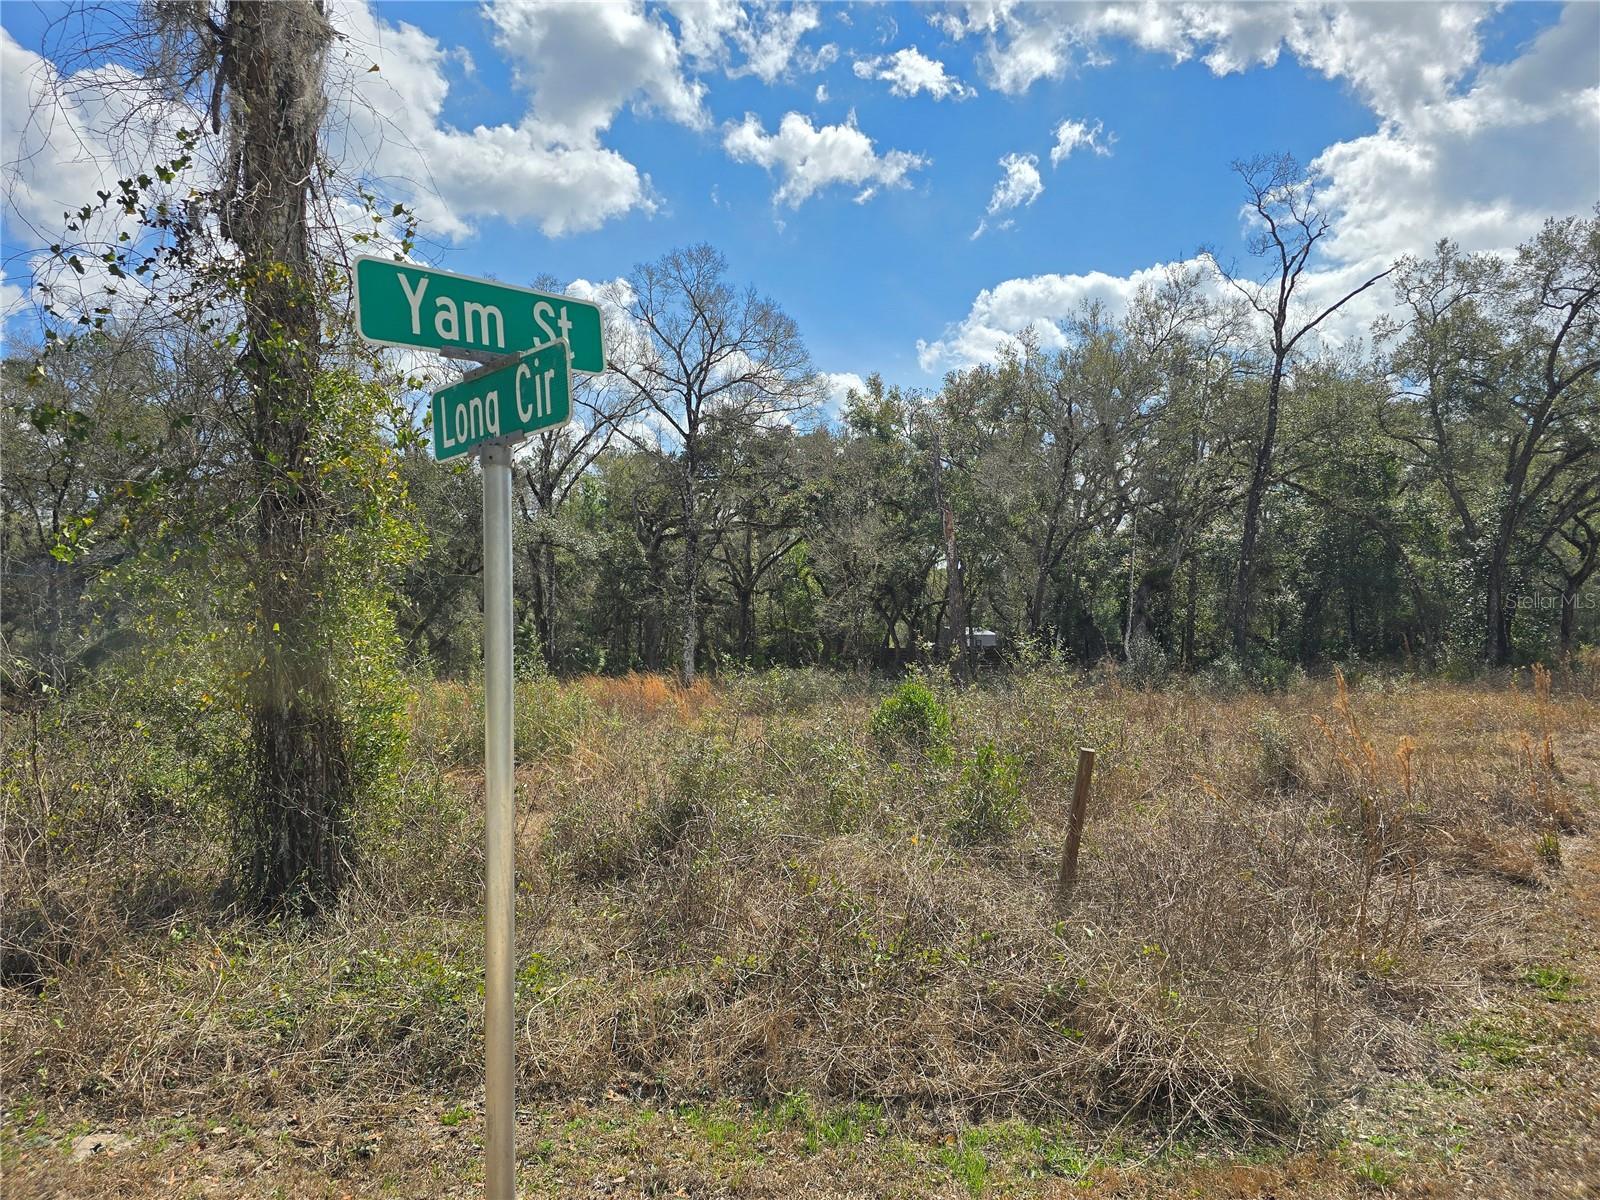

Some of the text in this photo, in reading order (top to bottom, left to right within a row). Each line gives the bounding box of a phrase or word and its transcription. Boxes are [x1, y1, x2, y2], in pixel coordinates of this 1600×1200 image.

[397, 273, 575, 359] Yam St
[441, 358, 555, 448] Long Cir
